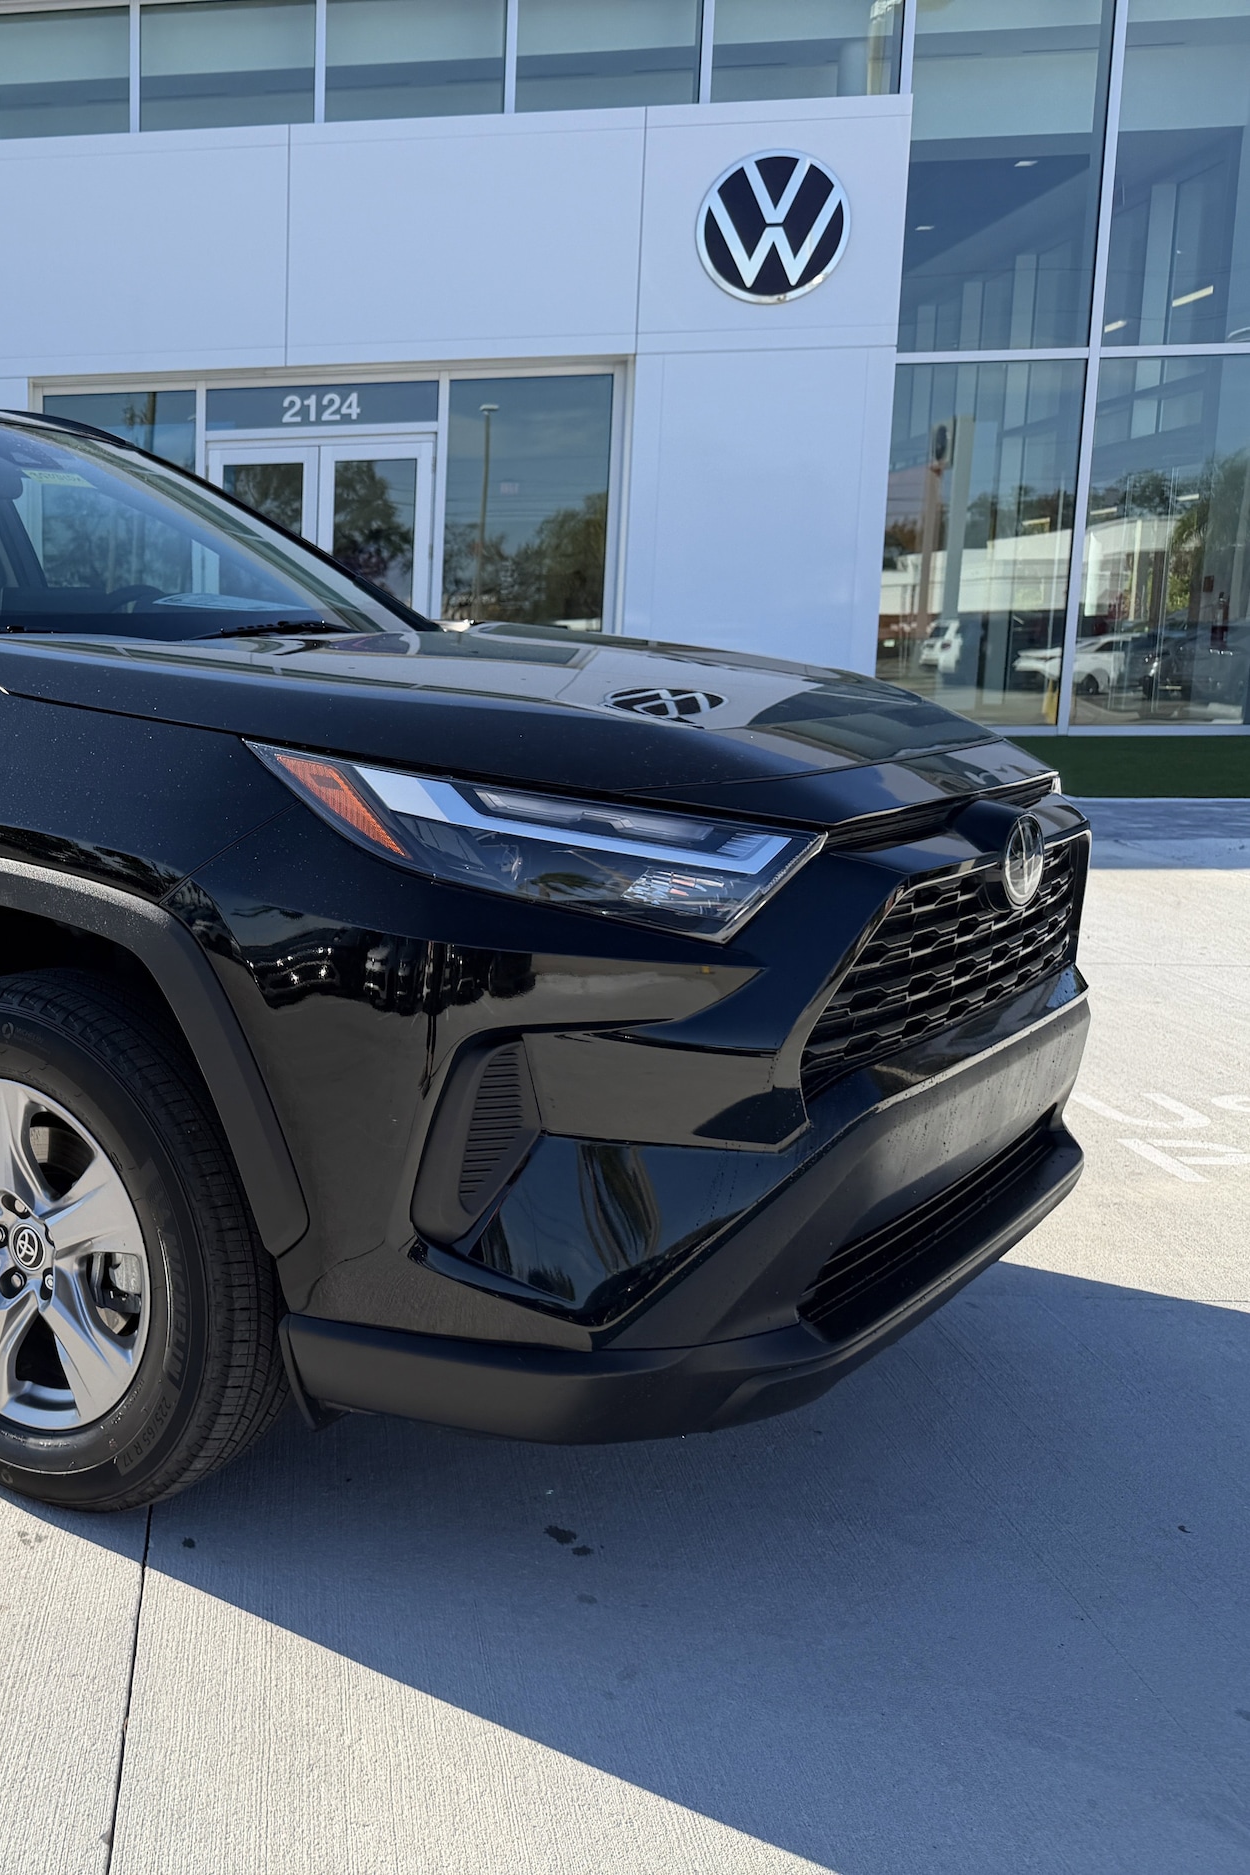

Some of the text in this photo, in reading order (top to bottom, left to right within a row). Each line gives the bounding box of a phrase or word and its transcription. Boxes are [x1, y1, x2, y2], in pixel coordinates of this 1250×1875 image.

[282, 392, 361, 423] 2124
[162, 1231, 187, 1383] MICHELIN
[123, 1395, 171, 1468] 225/65 R 17
